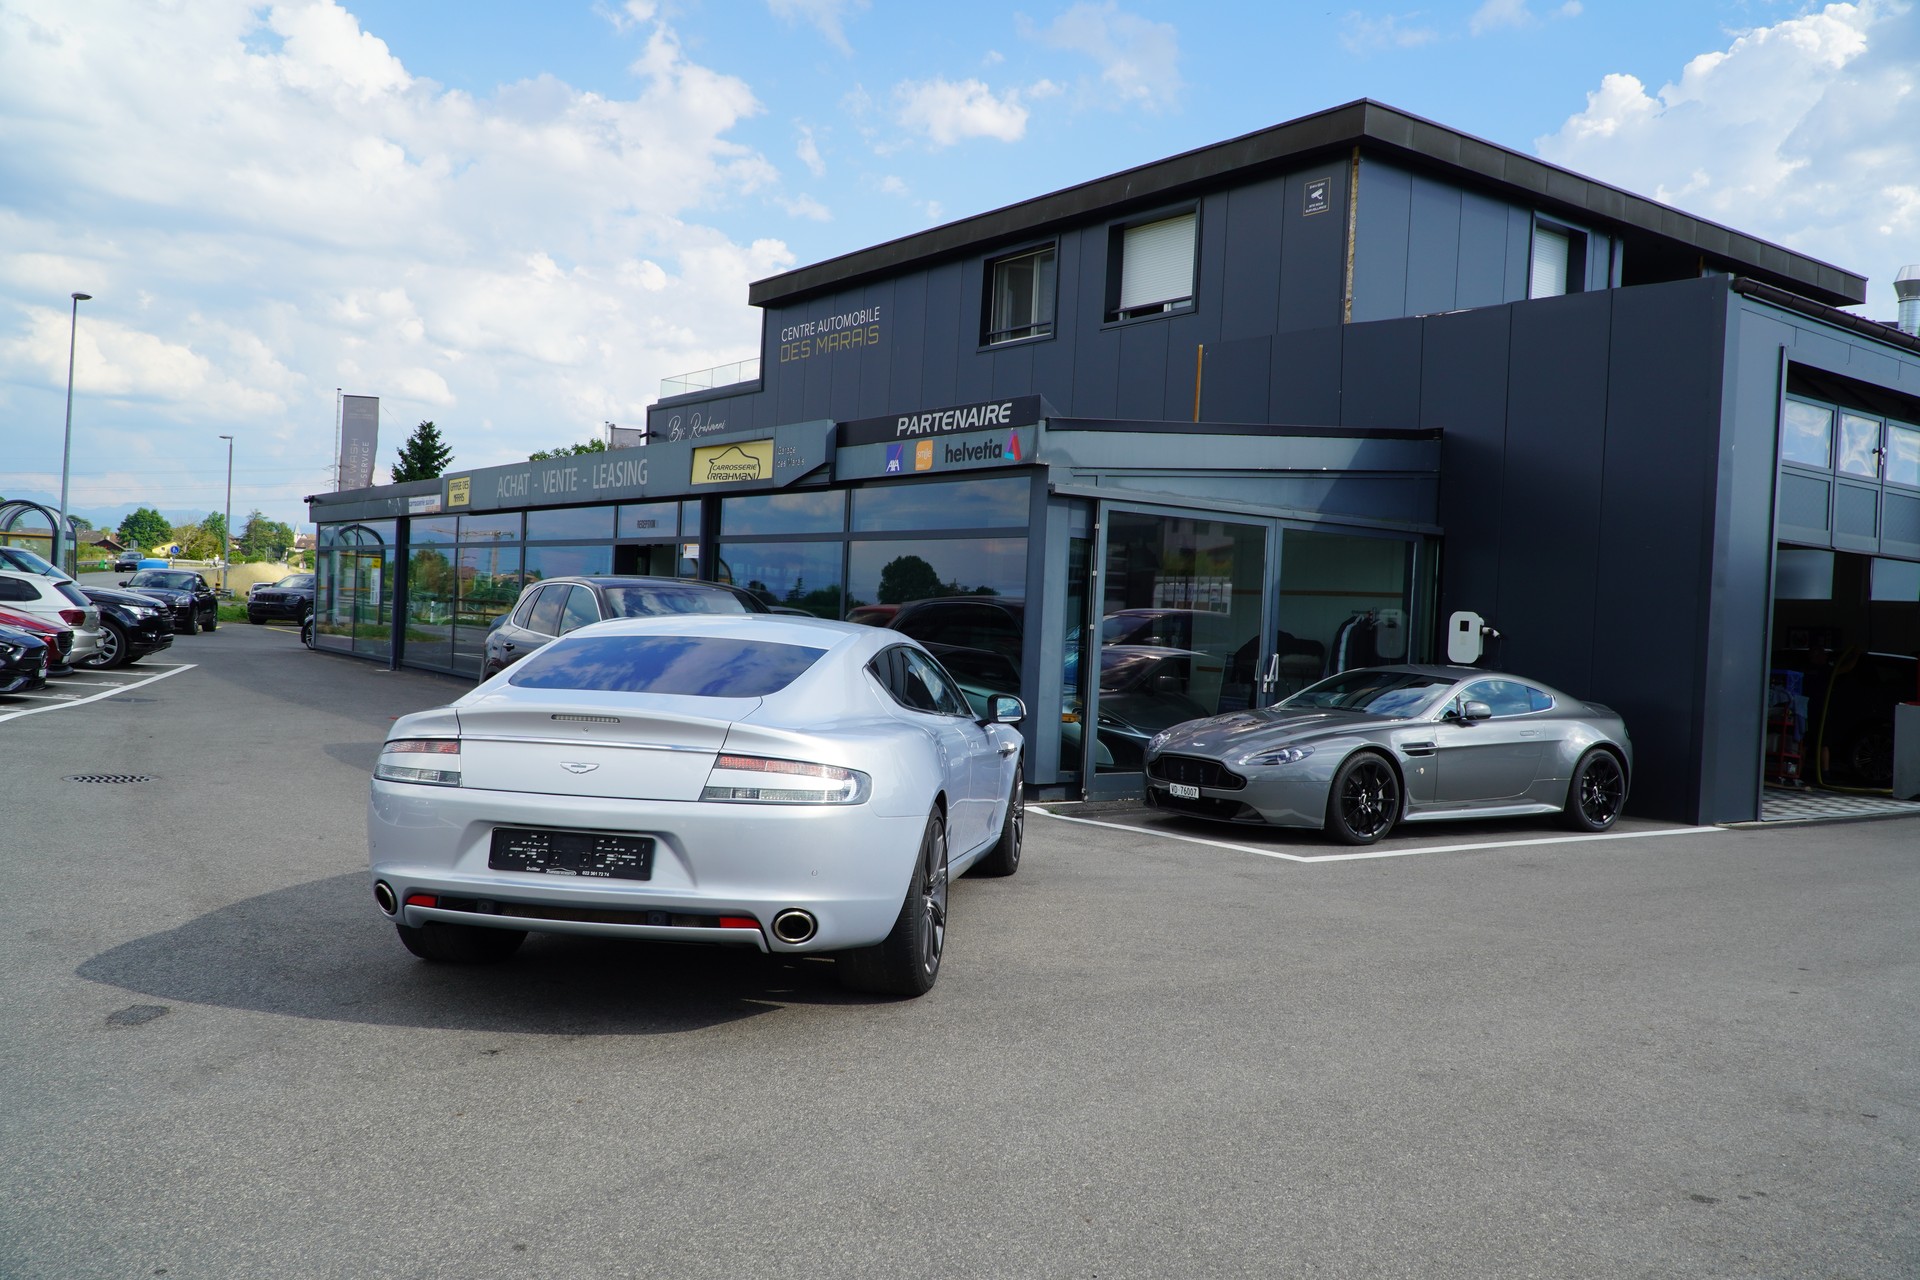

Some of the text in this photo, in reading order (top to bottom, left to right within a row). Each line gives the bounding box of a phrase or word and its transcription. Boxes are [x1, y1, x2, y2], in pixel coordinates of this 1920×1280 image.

[781, 306, 880, 342] CENTRE AUTOMOBILE
[780, 325, 879, 363] DES MARAIS
[896, 402, 1013, 436] PARTENAIRE
[944, 438, 1003, 463] helvetia
[496, 473, 530, 498] ACHAT
[542, 467, 578, 494] VENTE
[593, 459, 648, 489] LEASING
[712, 463, 757, 471] CARROSSERIE
[886, 459, 900, 473] AXA
[1171, 784, 1197, 797] VD 76007
